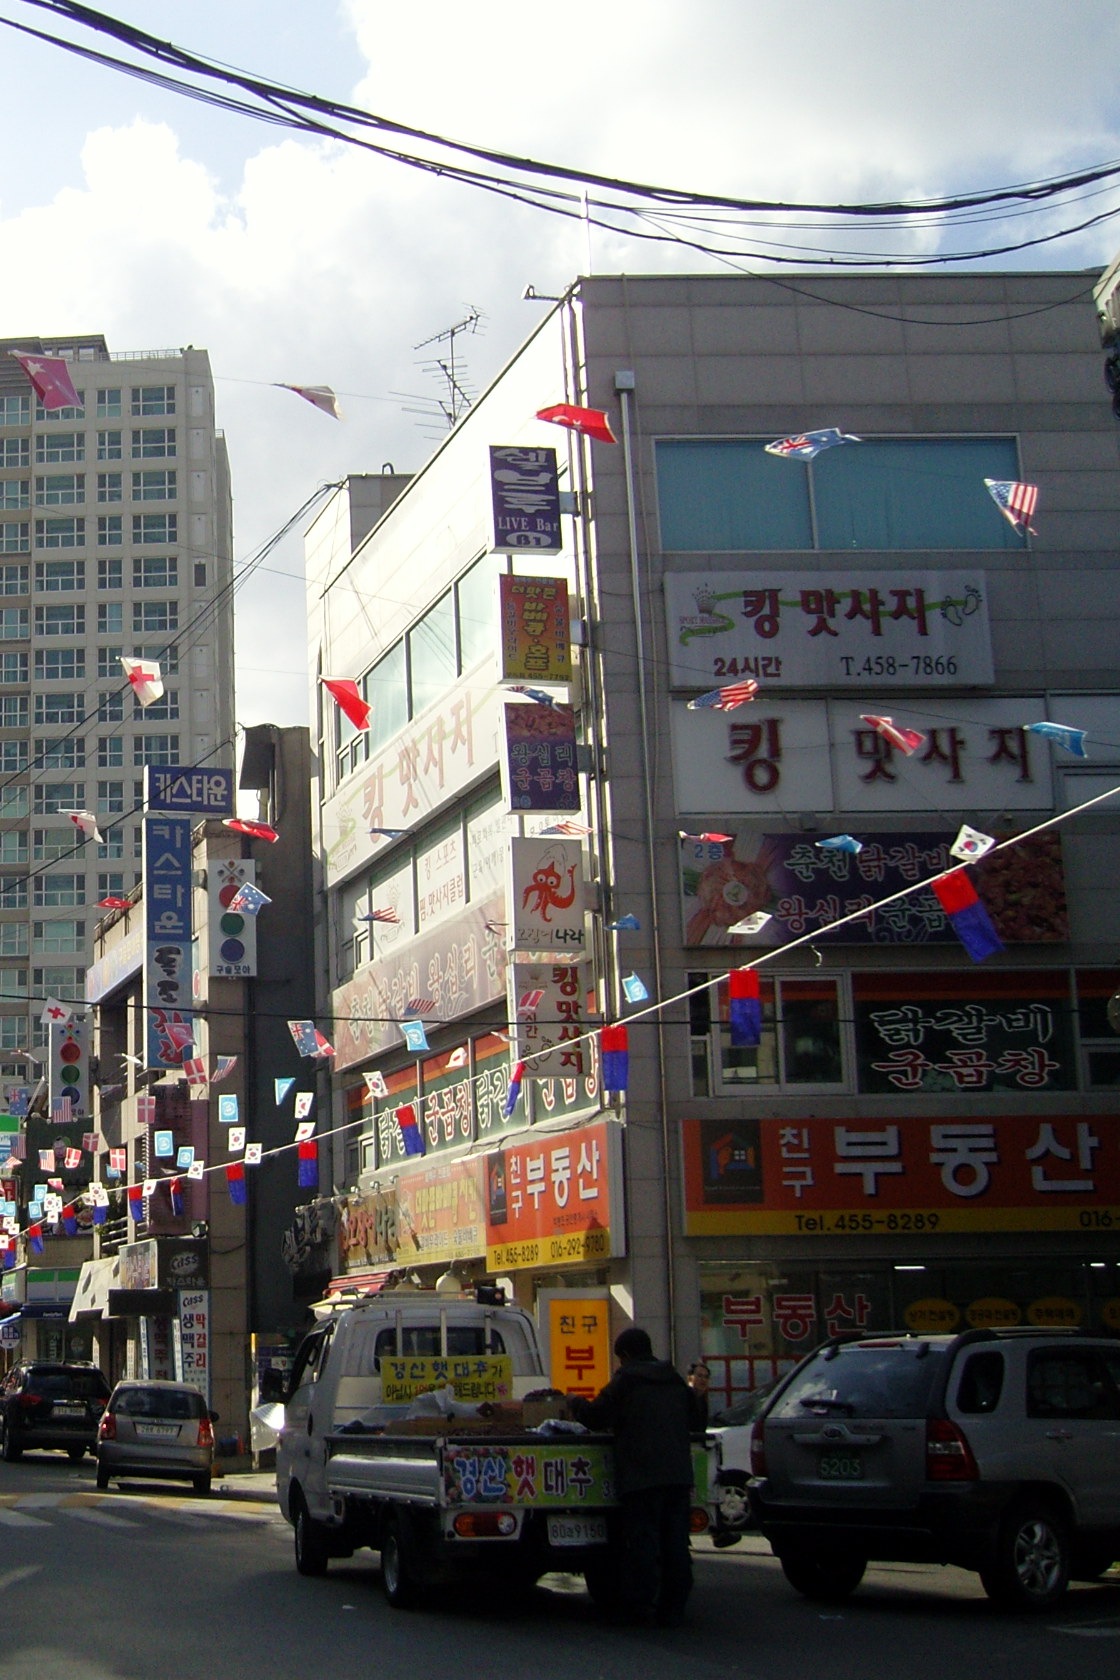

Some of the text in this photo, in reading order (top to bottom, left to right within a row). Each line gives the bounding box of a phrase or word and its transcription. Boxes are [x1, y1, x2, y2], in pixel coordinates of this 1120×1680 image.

[497, 516, 559, 532] LIVE Bar
[741, 586, 931, 639] 킹 맛사지
[712, 655, 783, 679] 24시간
[840, 654, 958, 678] T.458-7866
[362, 690, 475, 845] 킹 맛사지
[510, 742, 573, 766] 왕십리
[724, 717, 1033, 794] 킹 맛사지
[152, 825, 185, 935] 카스타운
[783, 843, 953, 882] 춘천닭갈비
[216, 964, 251, 975] 구슬모아
[869, 1004, 1054, 1046] 닭갈비
[870, 1047, 1061, 1090] 군곱창
[510, 1139, 600, 1219] 친구 부동산
[778, 1122, 1100, 1199] 친구 부동산
[795, 1212, 941, 1232] Tel.455-8289
[171, 1253, 199, 1271] Cass
[182, 1294, 204, 1308] Cass
[722, 1293, 872, 1342] 부동산
[182, 1312, 195, 1369] 생맥주
[195, 1312, 207, 1369] 막걸리
[560, 1314, 599, 1335] 친구
[454, 1455, 506, 1498] 경산
[511, 1454, 538, 1500] 햇
[542, 1455, 594, 1499] 대추
